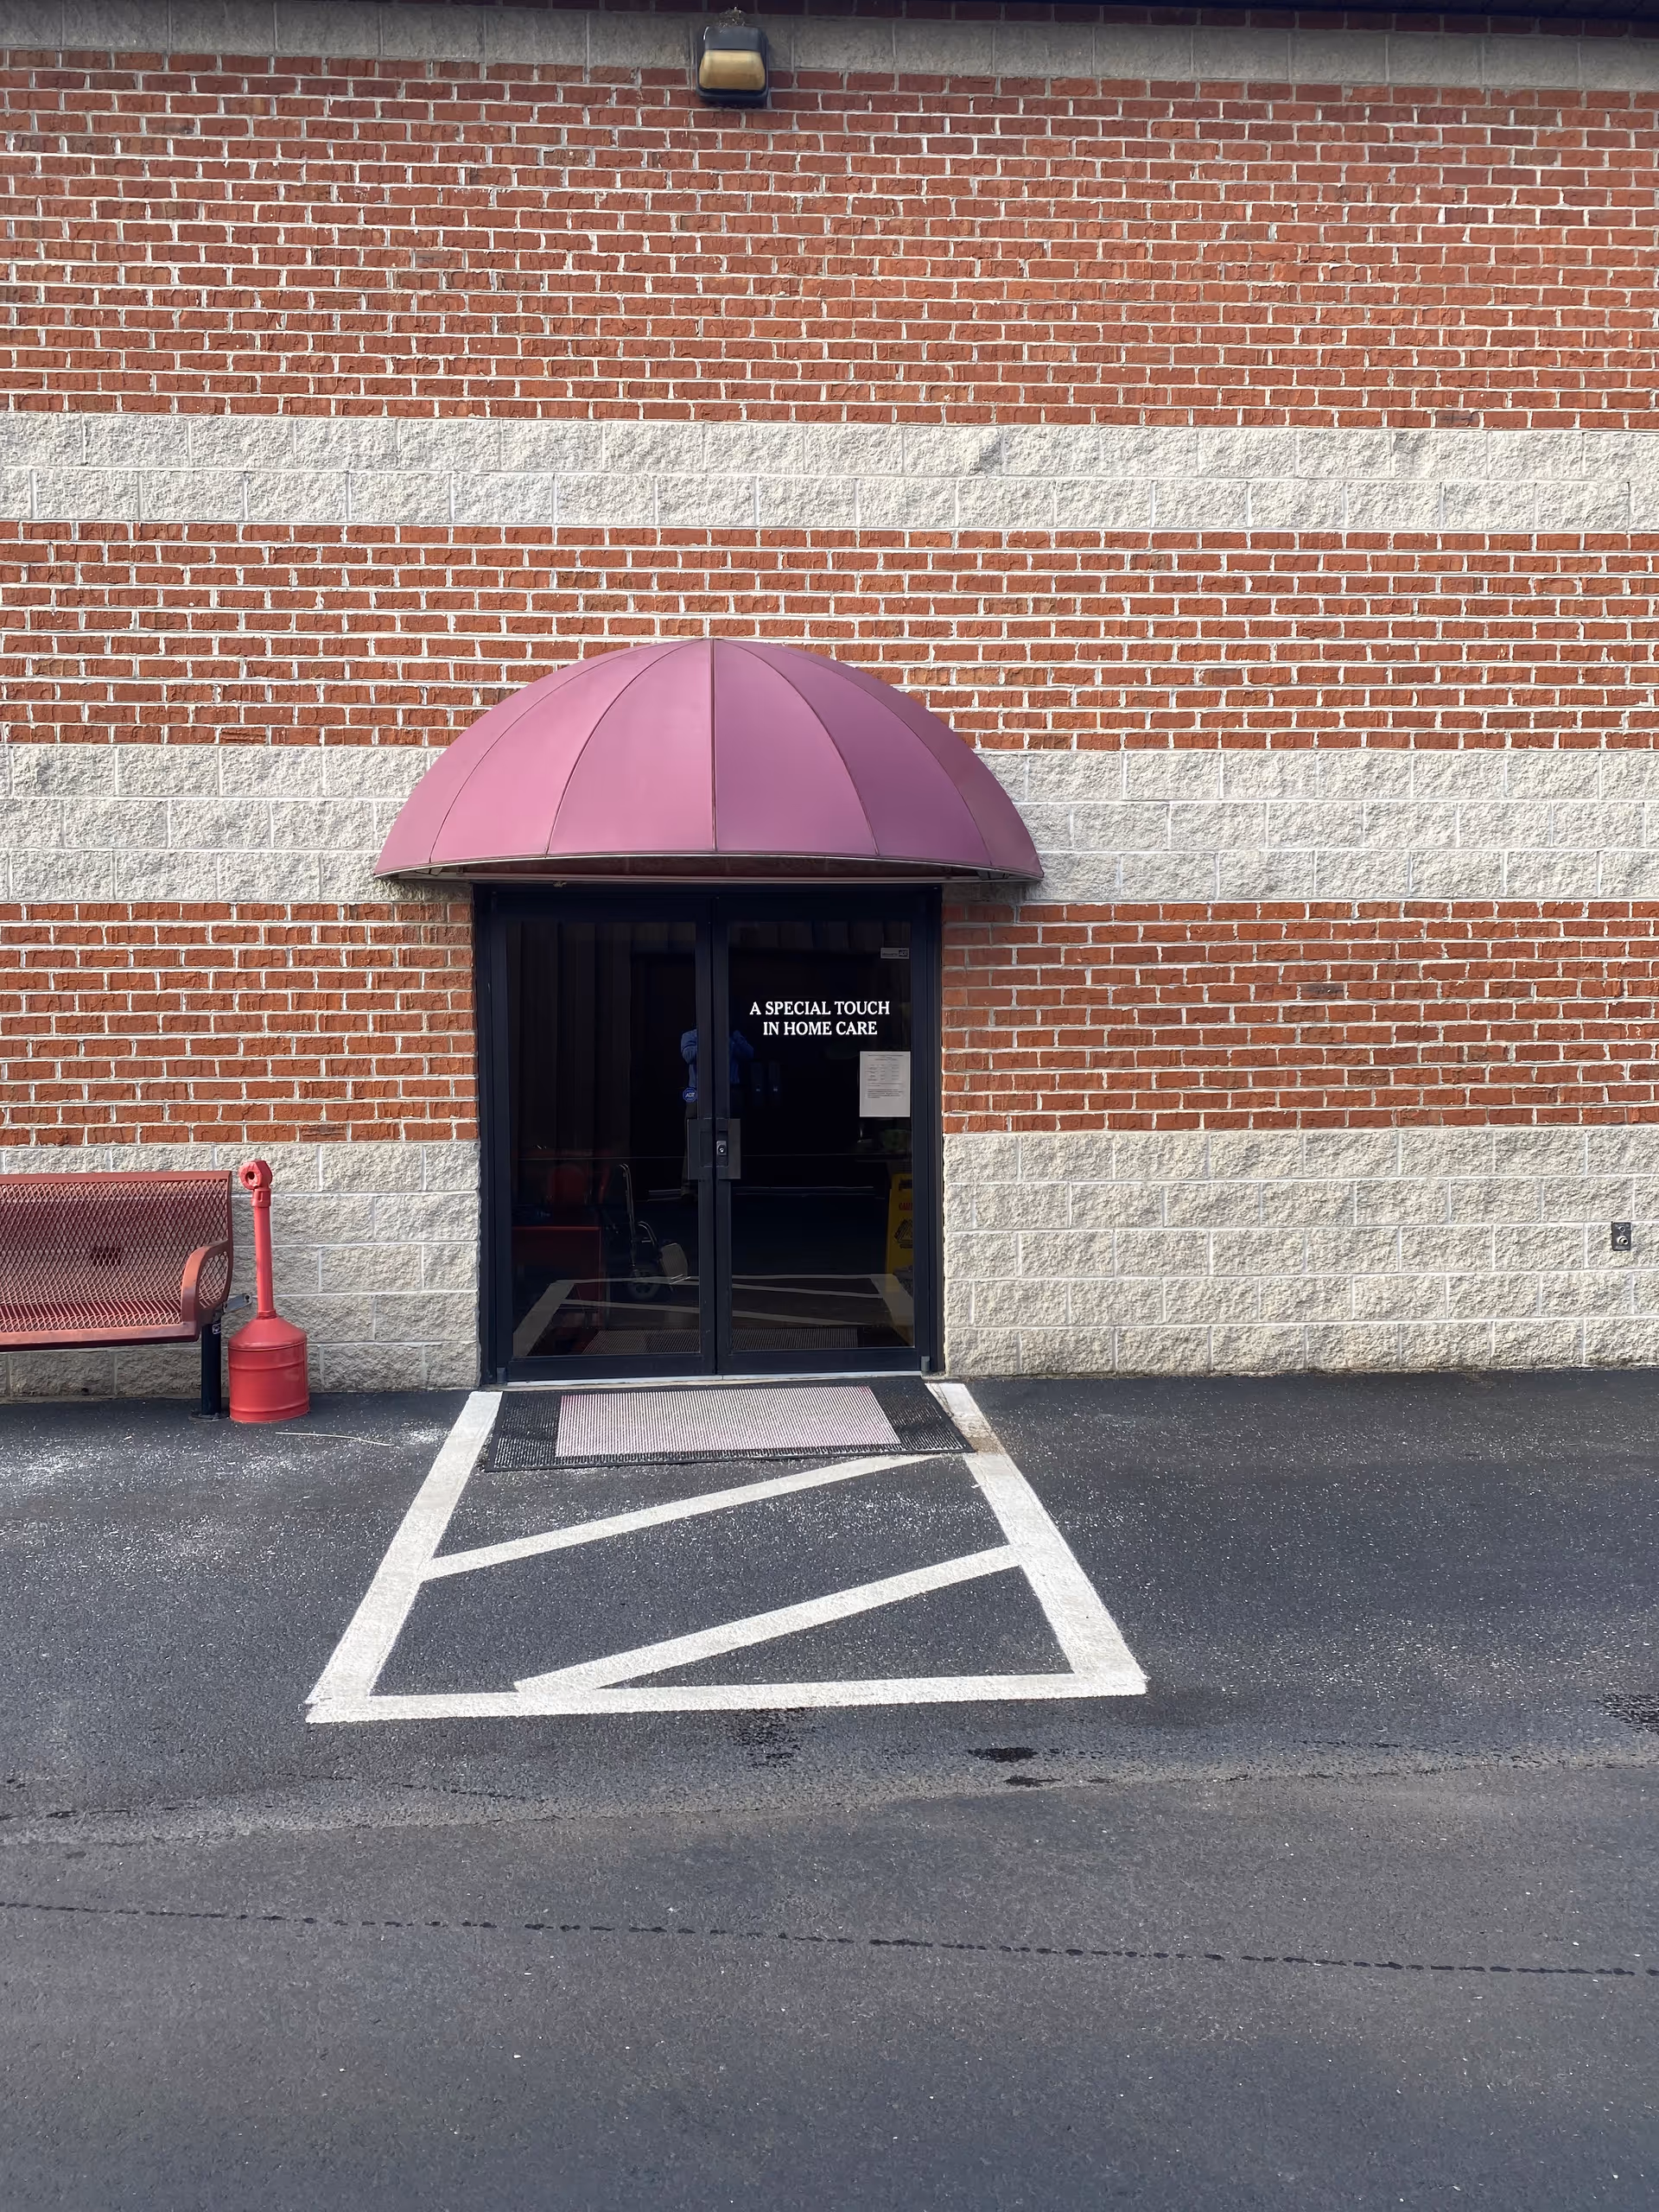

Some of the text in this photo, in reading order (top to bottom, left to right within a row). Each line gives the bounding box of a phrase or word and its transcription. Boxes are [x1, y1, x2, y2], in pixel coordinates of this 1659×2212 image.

[749, 1001, 890, 1015] A SPECIAL TOUCH
[763, 1021, 878, 1035] IN HOME CARE
